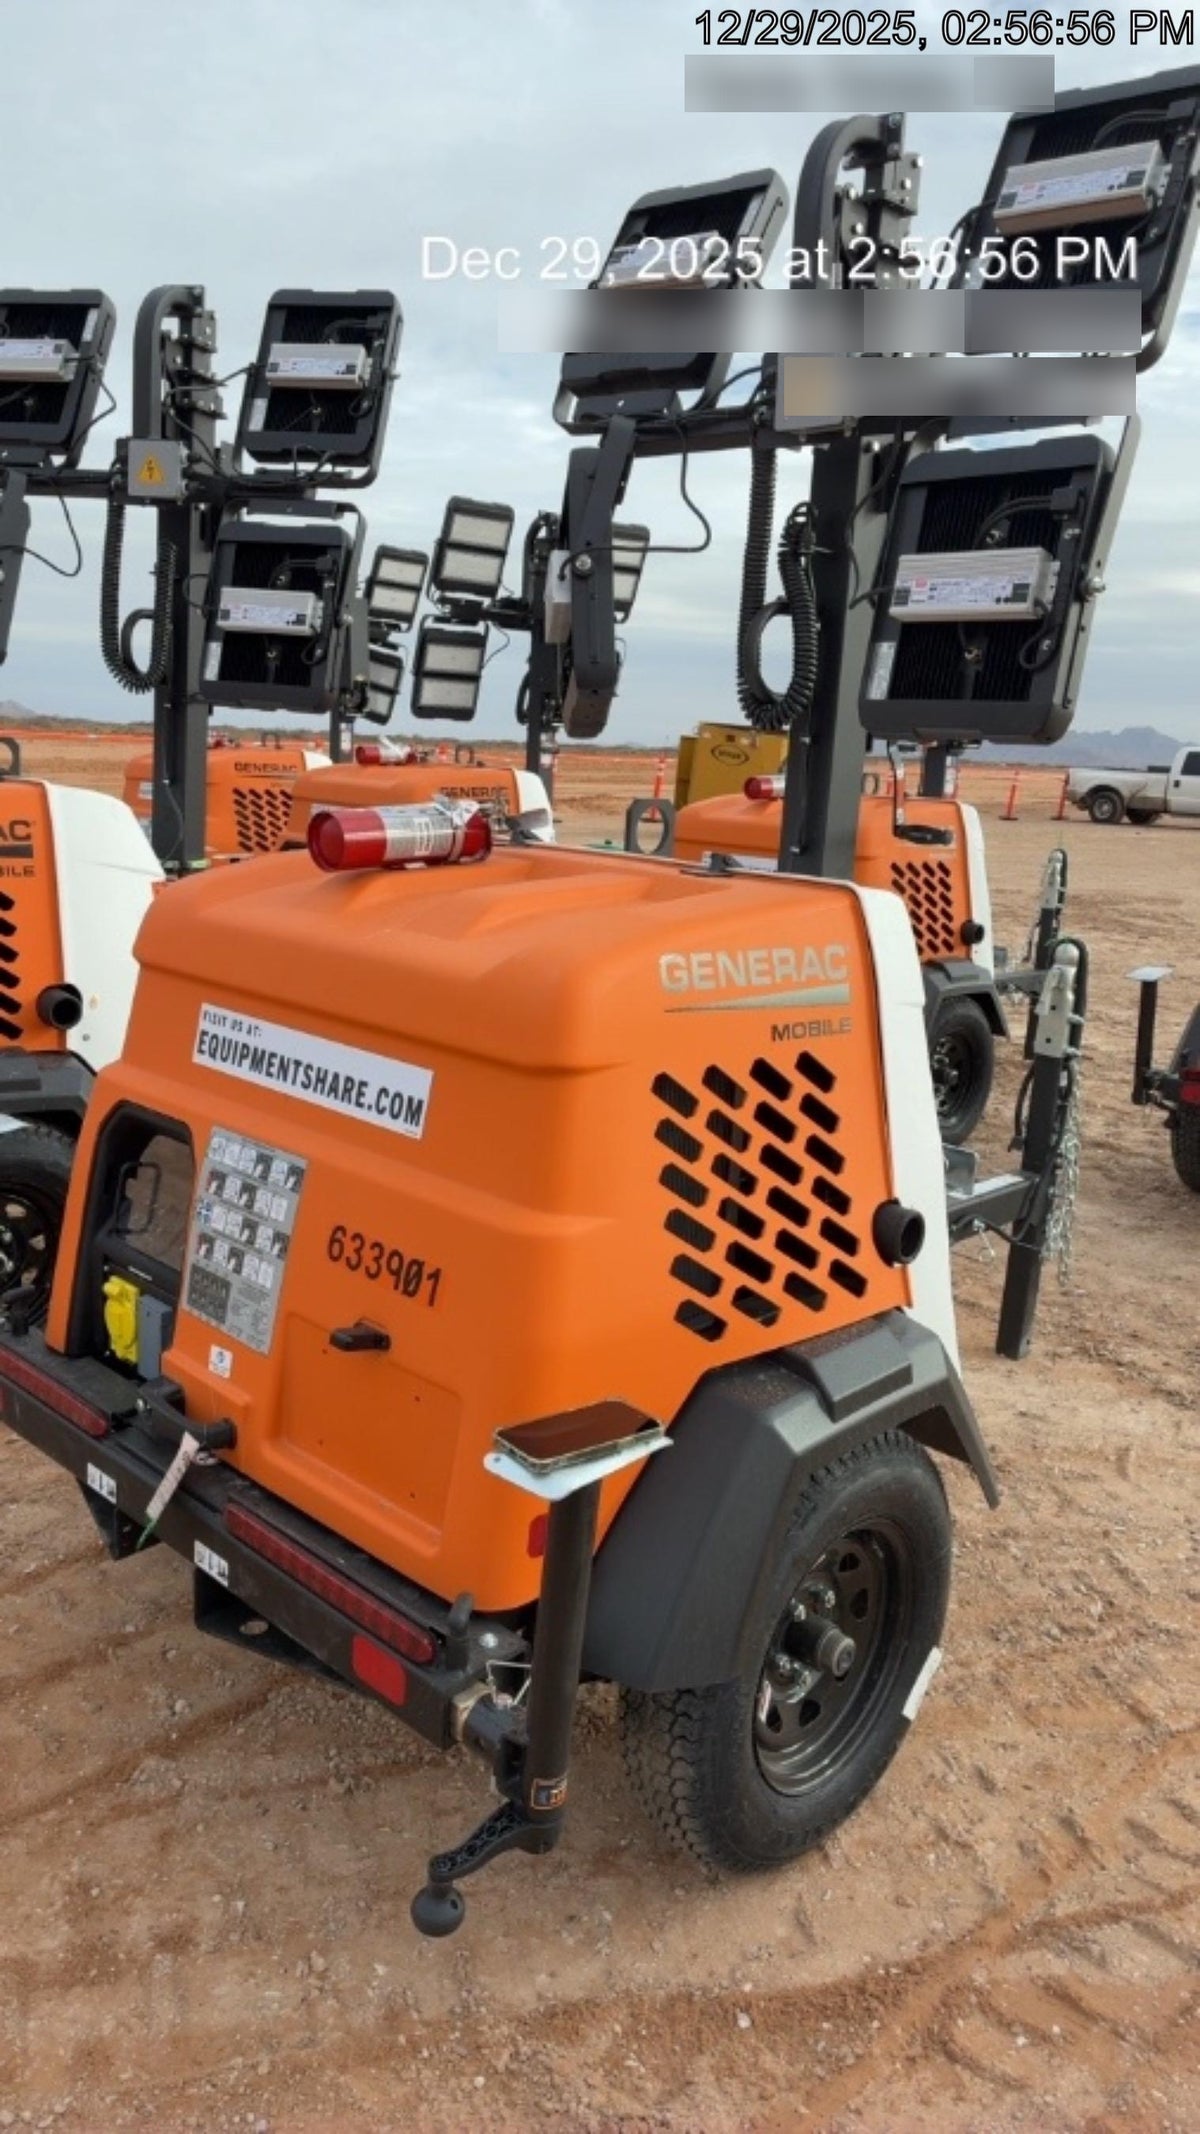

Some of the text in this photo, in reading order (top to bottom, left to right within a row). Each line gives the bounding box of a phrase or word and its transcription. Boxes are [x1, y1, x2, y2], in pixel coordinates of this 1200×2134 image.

[658, 943, 849, 995] GENERAC
[203, 1010, 262, 1038] VISIT US AT:
[771, 1016, 852, 1042] MOBILE
[196, 1029, 424, 1127] EQUIPMENTSHARE.COM
[328, 1225, 442, 1307] 633901
